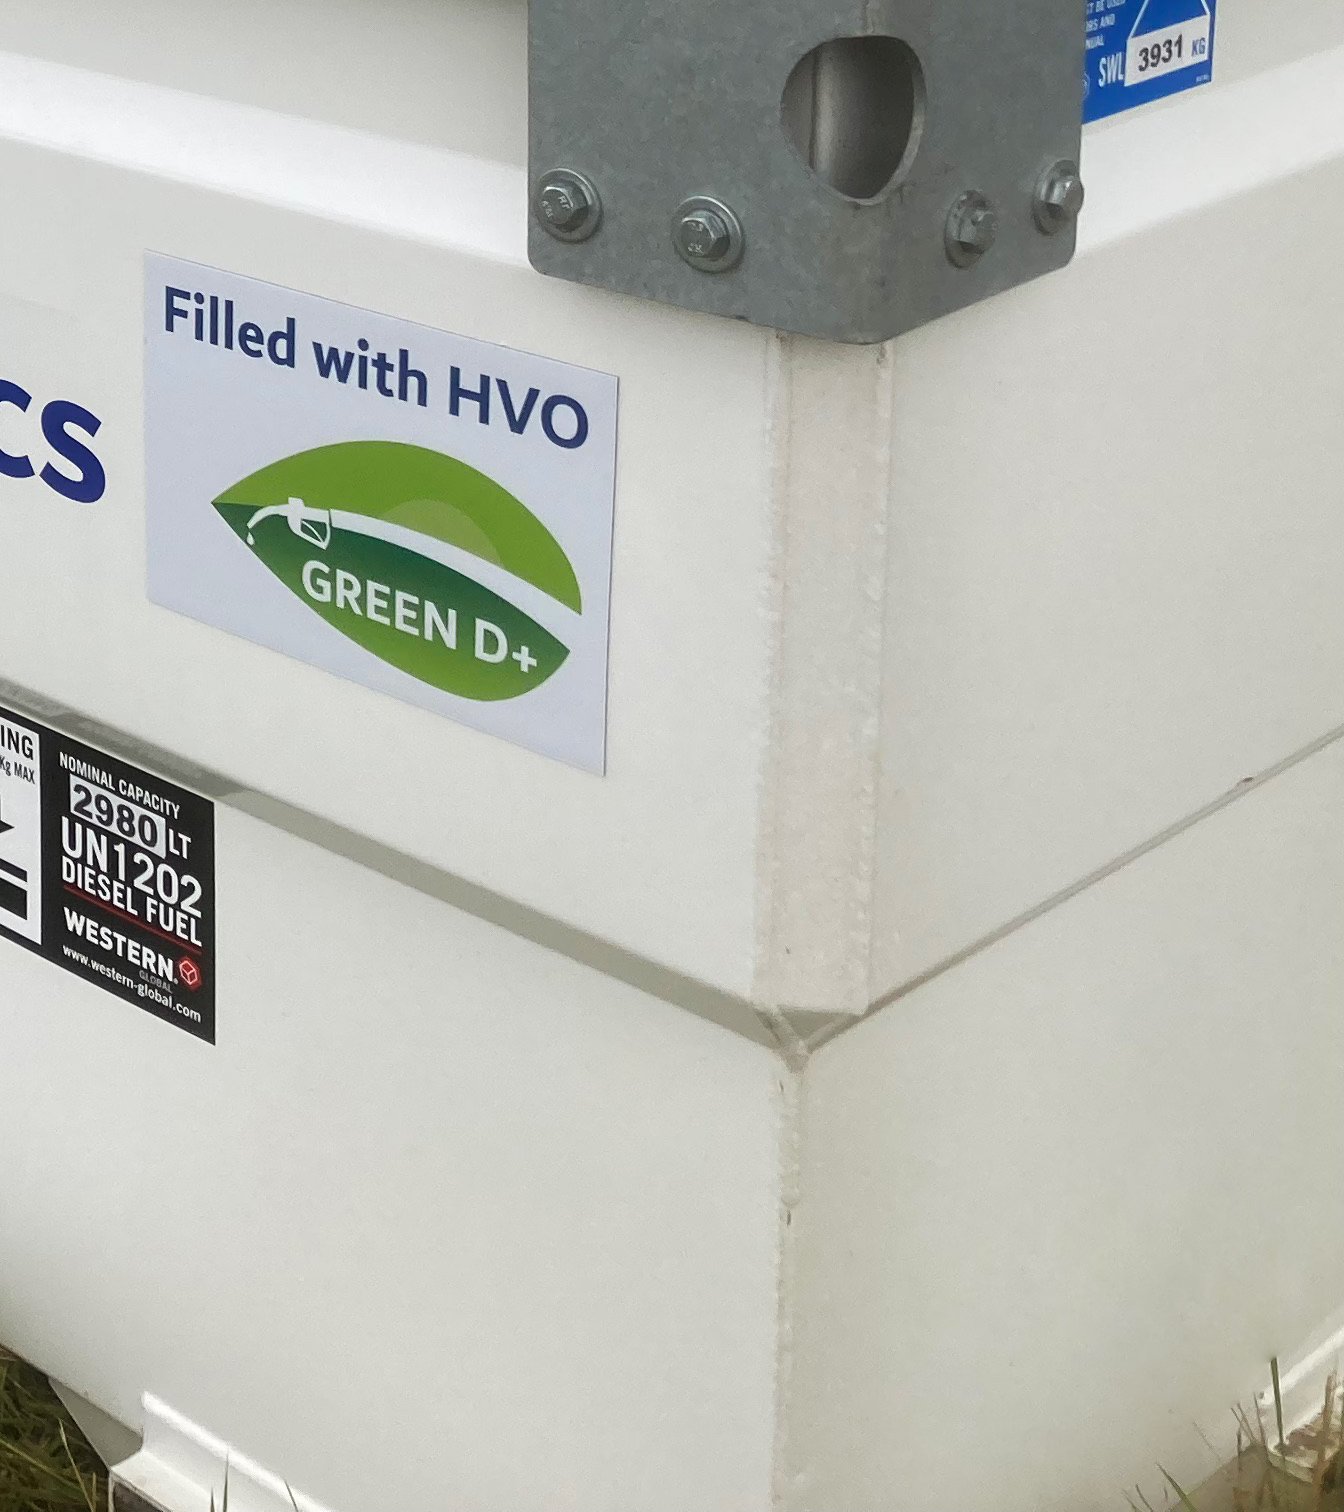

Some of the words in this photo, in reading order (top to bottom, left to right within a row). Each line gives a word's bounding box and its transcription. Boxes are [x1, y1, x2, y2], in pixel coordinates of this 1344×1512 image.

[1098, 52, 1124, 87] SWL
[1138, 34, 1182, 72] 3931
[1191, 37, 1206, 57] KG
[164, 285, 296, 368] Filled
[312, 338, 427, 408] with
[448, 366, 589, 449] HVO
[301, 560, 458, 650] GREEN
[474, 618, 537, 673] D+
[0, 755, 11, 776] Kg
[14, 762, 35, 784] MAX
[60, 751, 115, 790] NOMINAL
[118, 779, 180, 820] CAPACITY
[73, 784, 158, 848] 2980
[169, 828, 191, 859] LT
[62, 815, 202, 918] UN1202
[62, 855, 138, 916] DIESEL
[146, 896, 202, 947] FUEL
[63, 945, 202, 1023] www.western-global.com
[139, 970, 174, 994] GLOBAL
